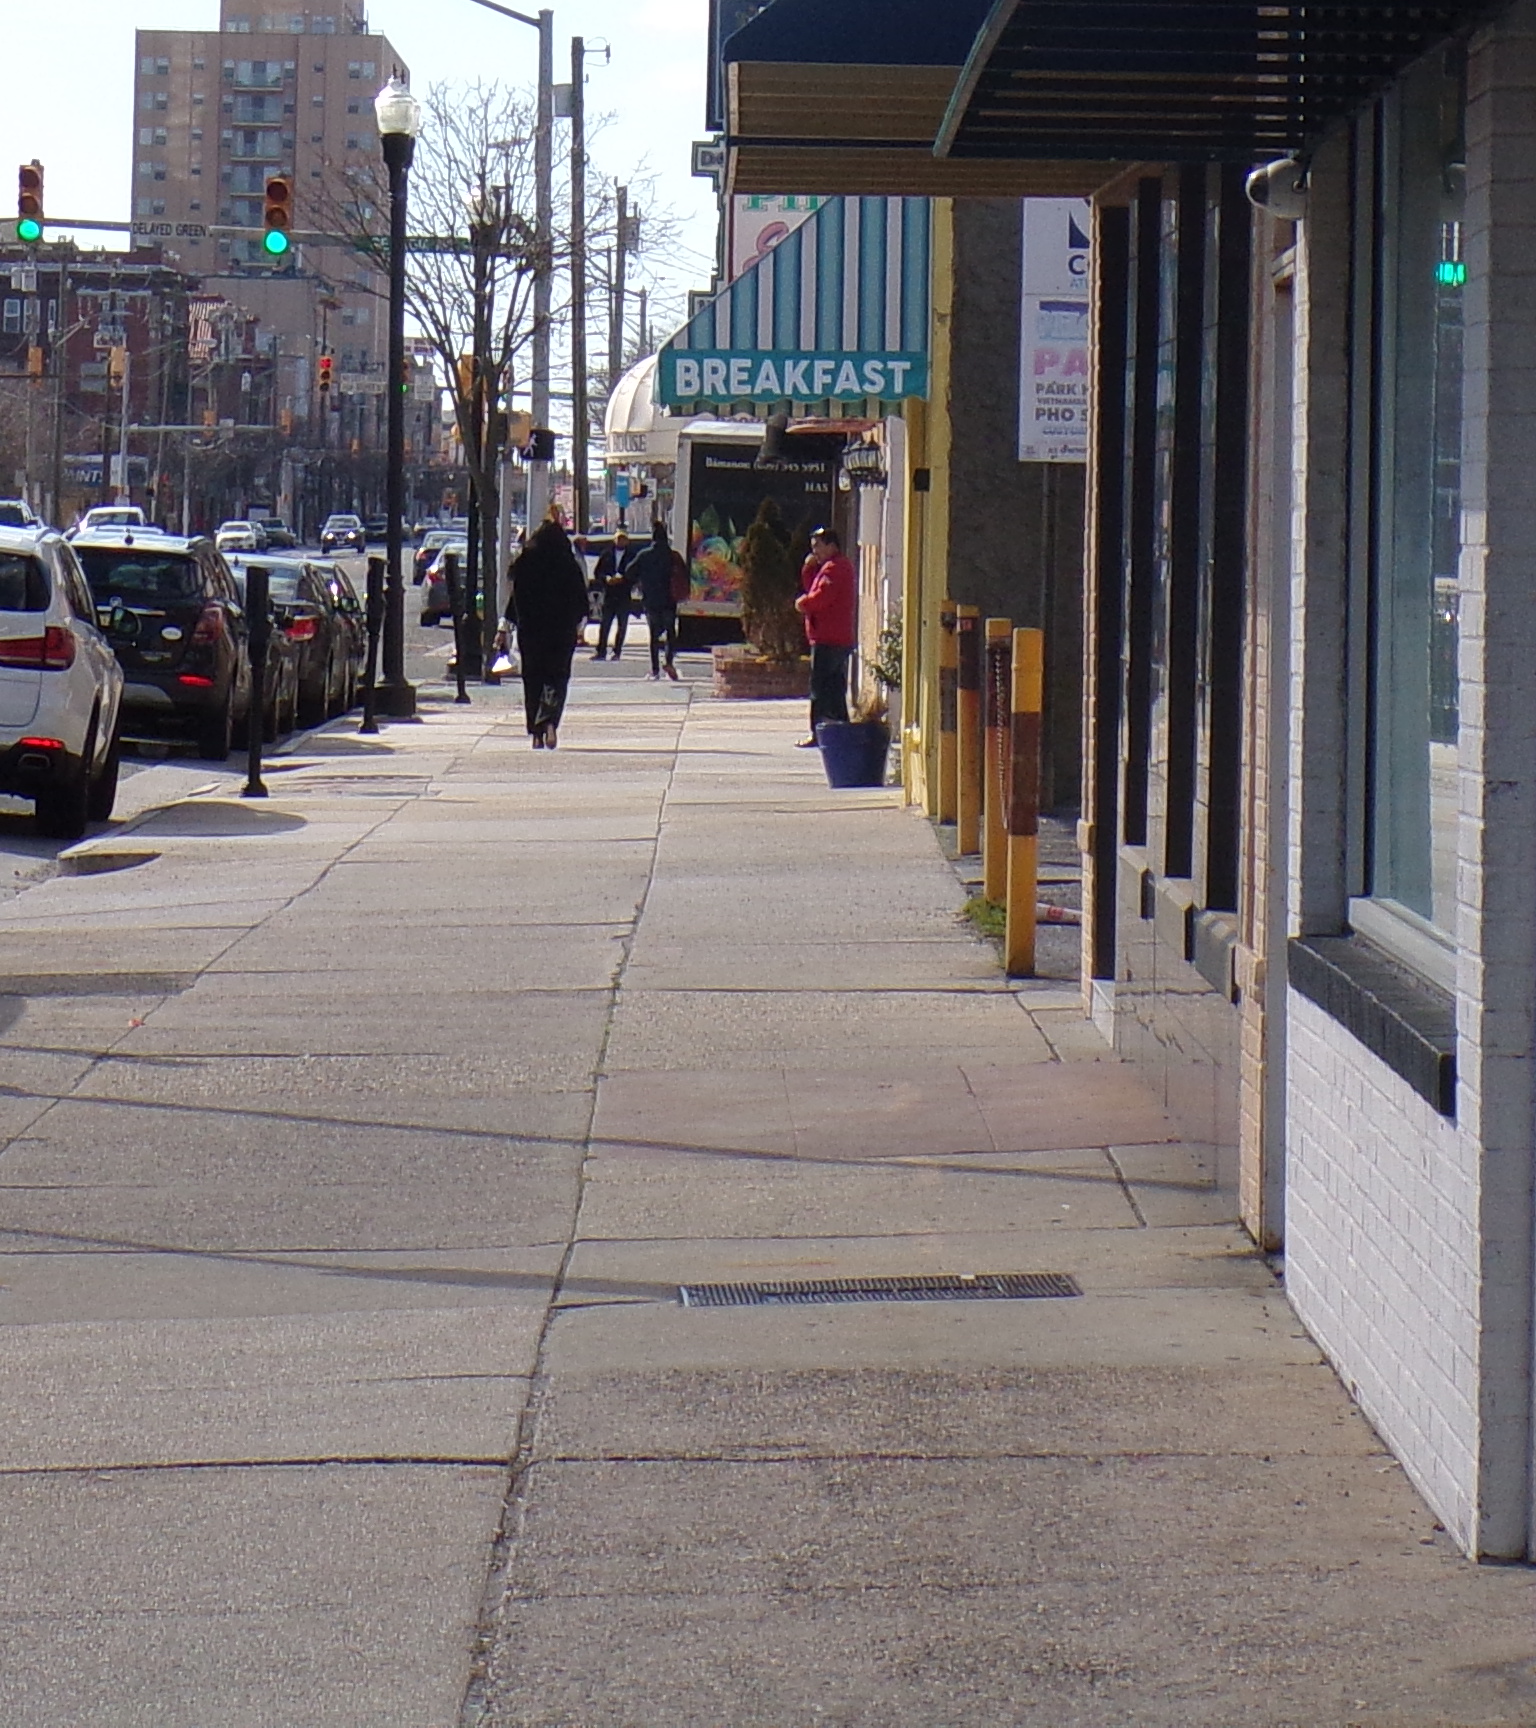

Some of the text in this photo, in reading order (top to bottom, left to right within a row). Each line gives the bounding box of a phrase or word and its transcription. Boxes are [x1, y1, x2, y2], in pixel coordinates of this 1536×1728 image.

[132, 222, 207, 237] DELAYED GREEN
[674, 355, 912, 397] BREAKFAST
[1034, 406, 1076, 422] PHO
